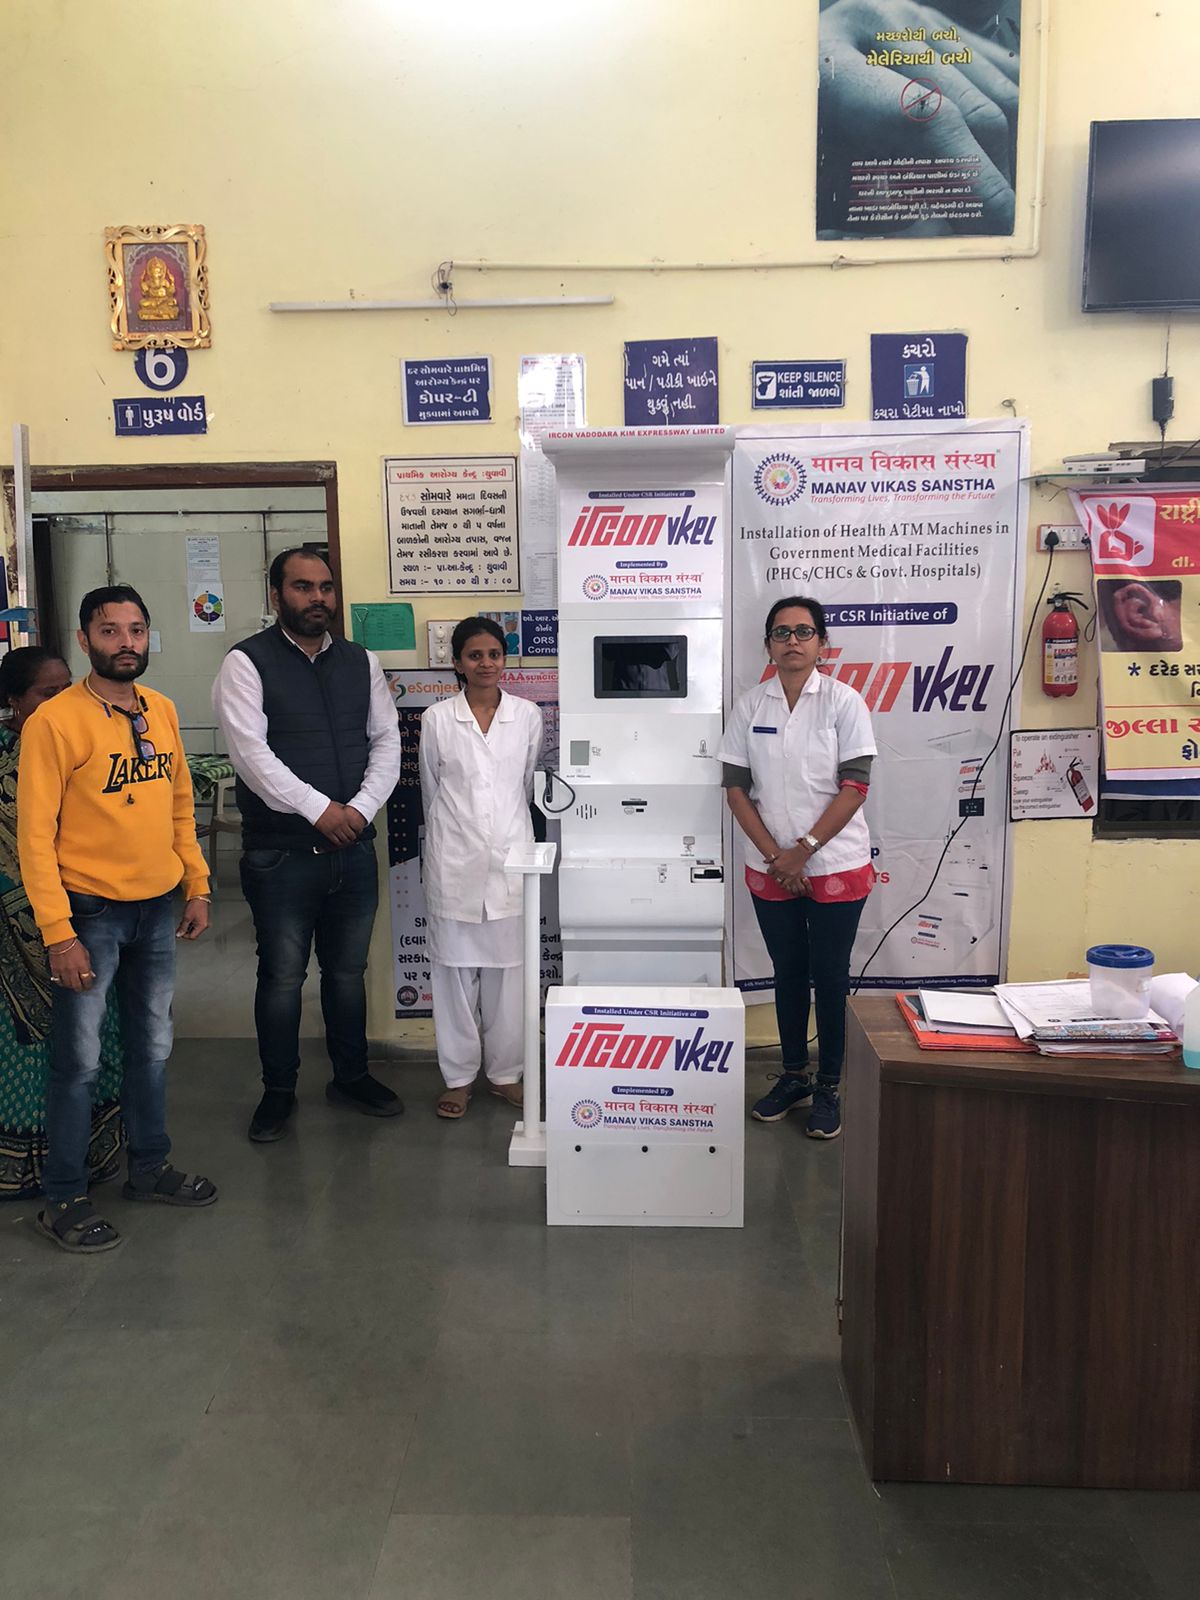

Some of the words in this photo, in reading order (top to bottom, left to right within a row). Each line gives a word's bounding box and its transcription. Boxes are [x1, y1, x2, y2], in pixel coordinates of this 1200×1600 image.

[876, 27, 925, 41] મચ્છરોથી
[931, 26, 960, 42] બચો,
[866, 50, 935, 66] મેલેરિયાથી
[941, 48, 973, 65] બચો
[901, 338, 936, 358] કચરો
[652, 350, 671, 367] ગમે
[674, 350, 690, 366] ત્યાં
[407, 367, 419, 375] દર
[420, 364, 453, 374] સોમવારે
[454, 362, 487, 373] પ્રાથમિક
[415, 377, 449, 386] આરોગ્ય
[625, 375, 646, 391] પાન
[657, 372, 683, 389] પડીકી
[778, 372, 801, 383] KEEP
[803, 371, 842, 383] SILENCE
[419, 388, 478, 404] કોપર-ટી
[806, 384, 841, 398] જાળવો
[142, 409, 174, 428] પુરૂષ
[177, 402, 204, 422] વોર્ડ
[419, 408, 451, 421] મુકવામાં
[453, 407, 480, 417] આવશે
[873, 405, 899, 421] કચરા
[901, 402, 933, 418] પેટીમા
[938, 400, 965, 417] નાખો
[637, 429, 691, 437] EXPRESSWAY
[812, 455, 863, 473] मानव
[870, 450, 936, 473] विकास
[944, 449, 997, 471] संस्था
[397, 470, 424, 479] પ્રાથમિક
[430, 468, 457, 478] આરોગ્ય
[463, 468, 477, 480] કેન્દ્ર
[811, 481, 866, 495] MANAV
[870, 480, 917, 493] VIKAS
[921, 478, 995, 492] SANSTHA
[420, 487, 452, 501] સોમવારે
[480, 489, 507, 500] દિવસની
[811, 495, 866, 505] Transforming
[867, 495, 890, 504] Lives,
[893, 493, 949, 503] Transforming
[951, 492, 966, 500] the
[967, 492, 995, 500] Future
[400, 506, 426, 517] ઉજવણી
[431, 507, 458, 516] દરમ્યાન
[401, 520, 426, 530] માતાની
[430, 520, 448, 530] તેમજ
[463, 520, 471, 529] થી
[486, 519, 506, 528] વર્ષના
[740, 526, 821, 539] Installation
[823, 525, 837, 538] of
[840, 524, 886, 538] Health
[889, 524, 923, 536] ATM
[927, 522, 993, 535] Machines
[995, 522, 1009, 534] in
[397, 534, 429, 545] બાળકોની
[434, 533, 461, 544] આરોગ્ય
[465, 535, 488, 544] તપાસ,
[493, 535, 512, 543] વજન
[396, 548, 414, 559] તેમજ
[419, 549, 448, 558] રસીકરણ
[453, 547, 479, 557] કરવામાં
[483, 547, 498, 557] આવે
[503, 546, 513, 557] છે.
[769, 546, 855, 560] Government
[857, 545, 912, 558] Medical
[916, 543, 979, 556] Facilities
[403, 564, 419, 572] સ્થળ
[620, 561, 655, 569] Implemented
[656, 561, 664, 569] By
[1171, 556, 1195, 569] તા.
[610, 574, 636, 584] मानव
[639, 572, 672, 584] विकास
[676, 572, 702, 584] संस्था
[766, 565, 854, 583] (PHCs/CHCs
[856, 566, 868, 578] &
[870, 564, 908, 578] Govt.
[910, 562, 981, 581] Hospitals)
[399, 577, 417, 586] સમય
[471, 575, 480, 585] થી
[665, 587, 702, 595] SANSTHA
[839, 608, 867, 622] CSR
[870, 607, 929, 621] Initiative
[932, 606, 947, 621] of
[535, 624, 553, 632] કોર્નર
[533, 636, 555, 644] ORS
[1149, 659, 1180, 676] દરેક
[407, 680, 461, 695] eSanjee
[1106, 719, 1179, 738] જીલ્લા
[1049, 733, 1080, 742] extinguisher
[102, 752, 174, 794] LAKERS
[404, 971, 418, 981] પર
[623, 1008, 644, 1016] Under
[659, 1009, 689, 1017] Initiative
[617, 1086, 661, 1095] Implemented
[662, 1088, 669, 1096] By
[604, 1101, 636, 1113] मानव
[639, 1099, 679, 1114] विकास
[683, 1102, 715, 1116] संस्था
[604, 1116, 638, 1125] MANAV
[639, 1117, 667, 1126] VIKAS
[669, 1118, 714, 1128] SANSTHA
